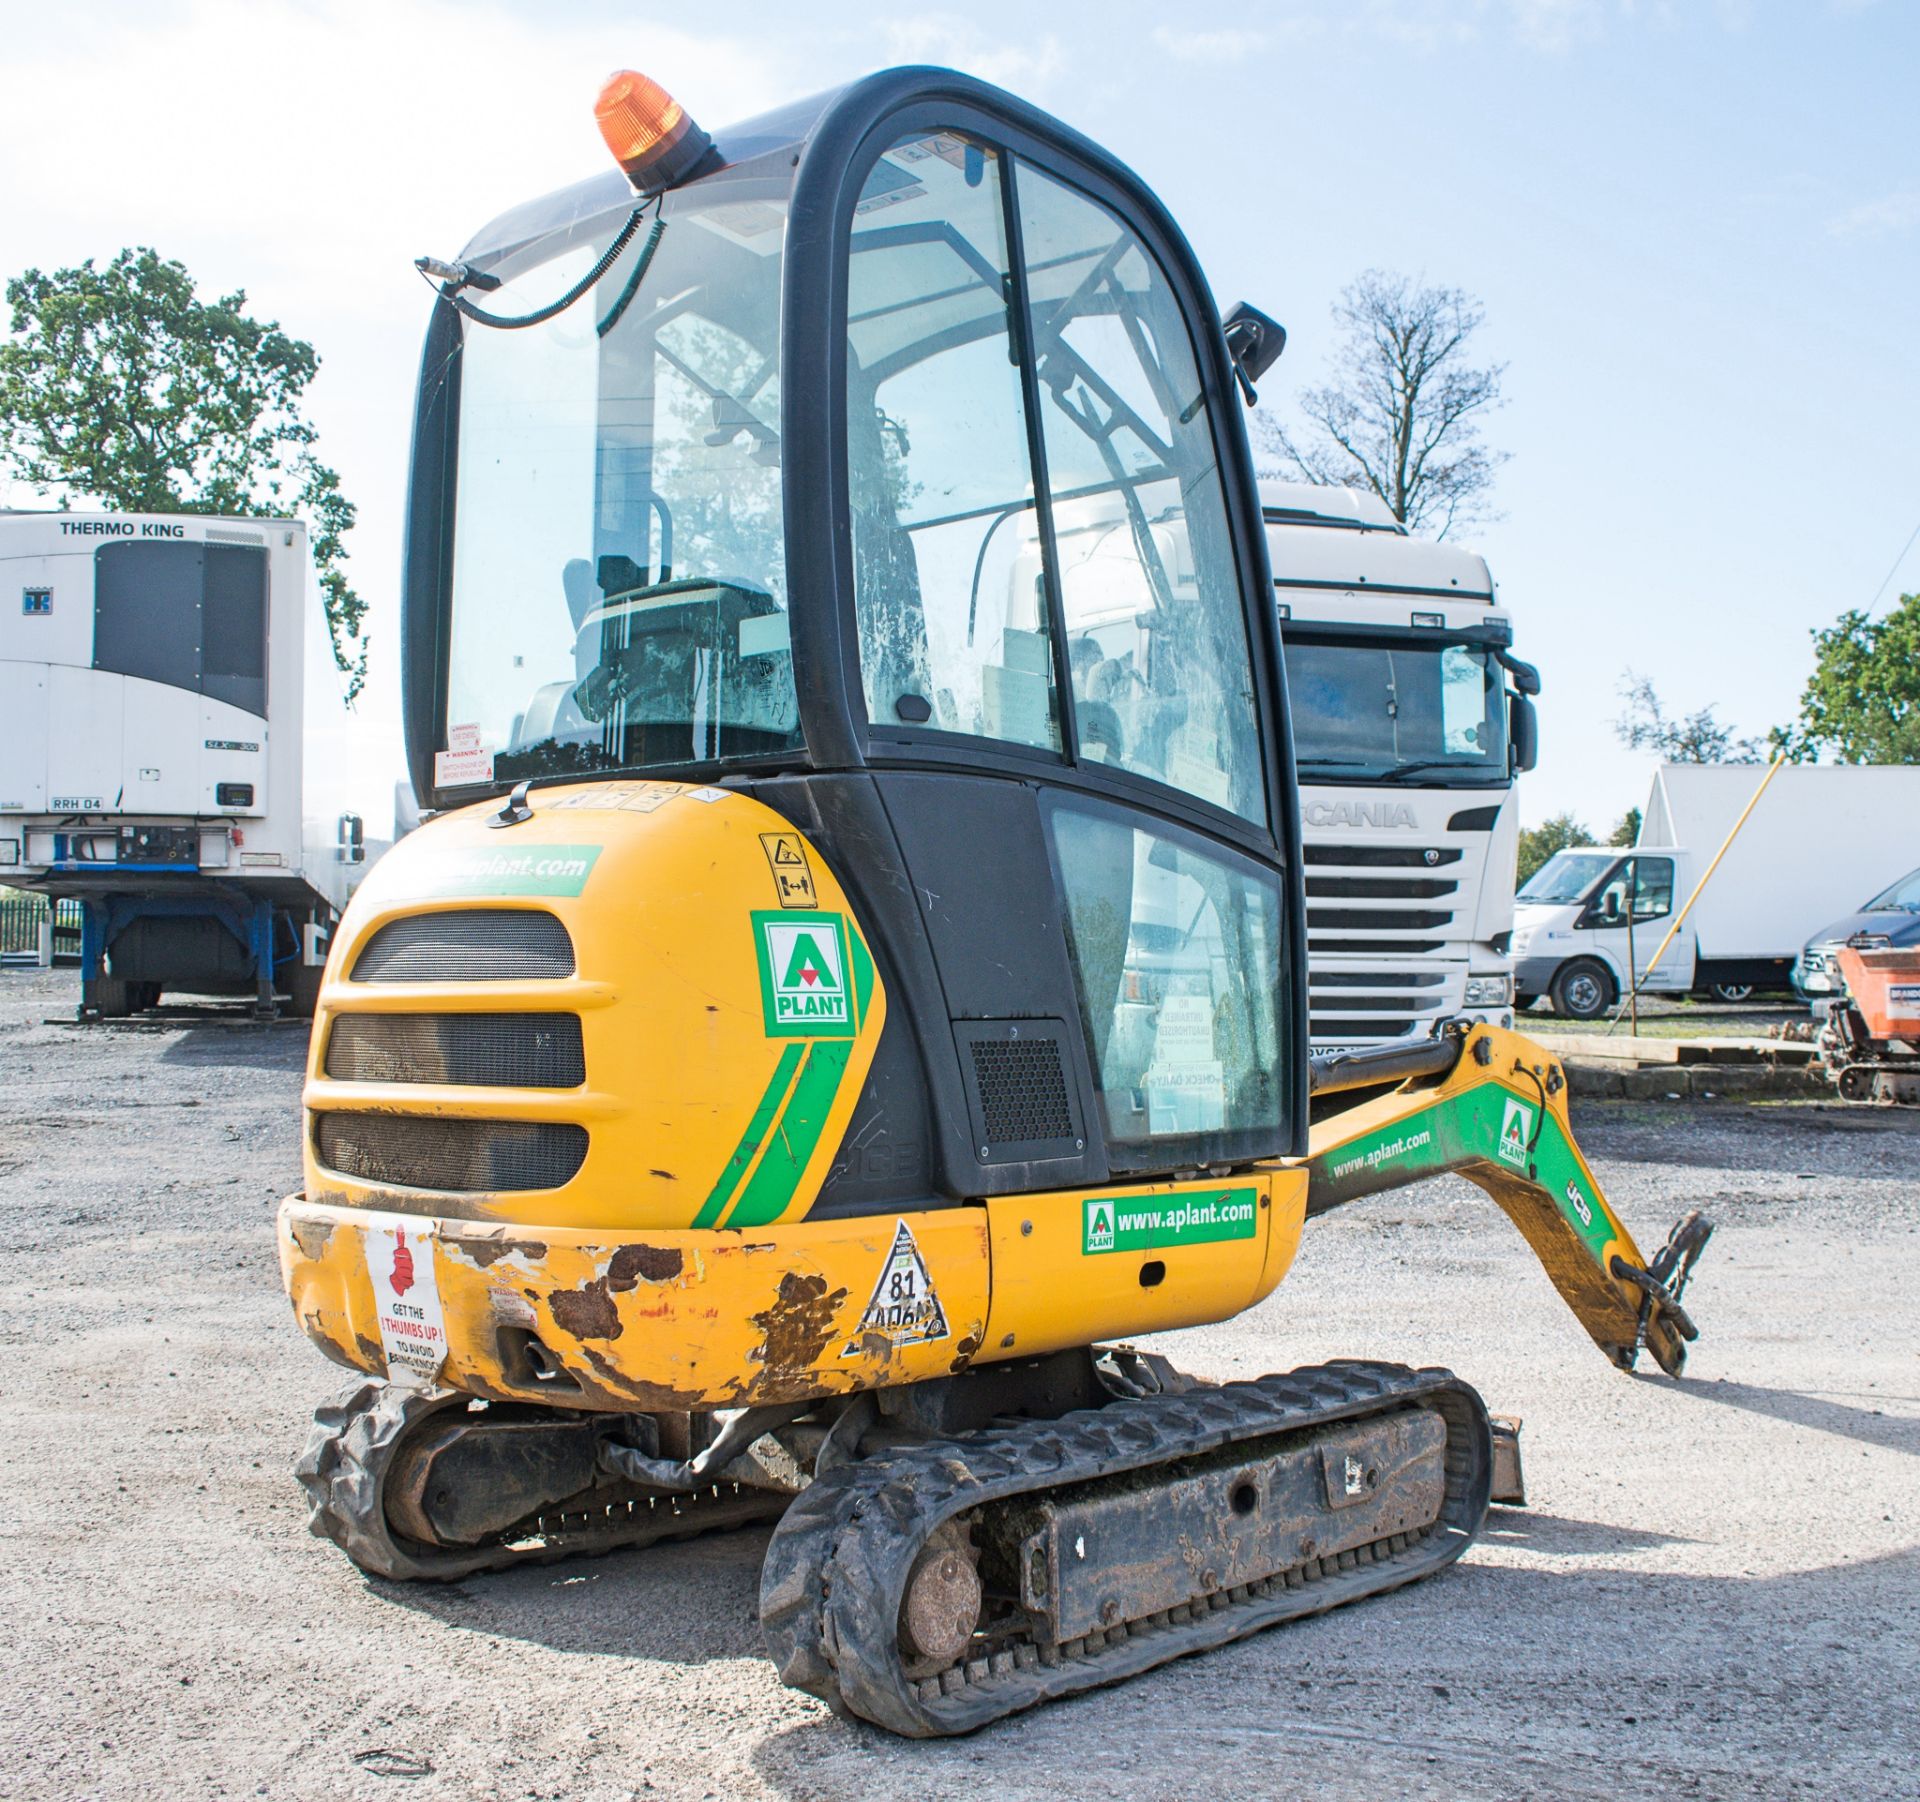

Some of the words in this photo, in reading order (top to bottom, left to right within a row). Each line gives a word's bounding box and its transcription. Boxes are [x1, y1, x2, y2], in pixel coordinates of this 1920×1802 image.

[60, 522, 134, 536] THERMO
[142, 523, 185, 538] KING
[452, 750, 478, 759] WARNING
[54, 799, 79, 809] RRH
[1302, 800, 1419, 828] CANIA
[777, 996, 844, 1016] PLANT
[1333, 1130, 1431, 1178] www.aplant.com
[1500, 1141, 1526, 1164] PLANT
[1566, 1182, 1592, 1228] JCB
[1117, 1202, 1253, 1234] www.aplant.com
[1088, 1236, 1113, 1248] PLANT
[891, 1269, 916, 1302] 81
[392, 1303, 408, 1317] GET
[408, 1306, 425, 1320] THE
[396, 1340, 409, 1353] TO
[409, 1343, 435, 1358] AVOID
